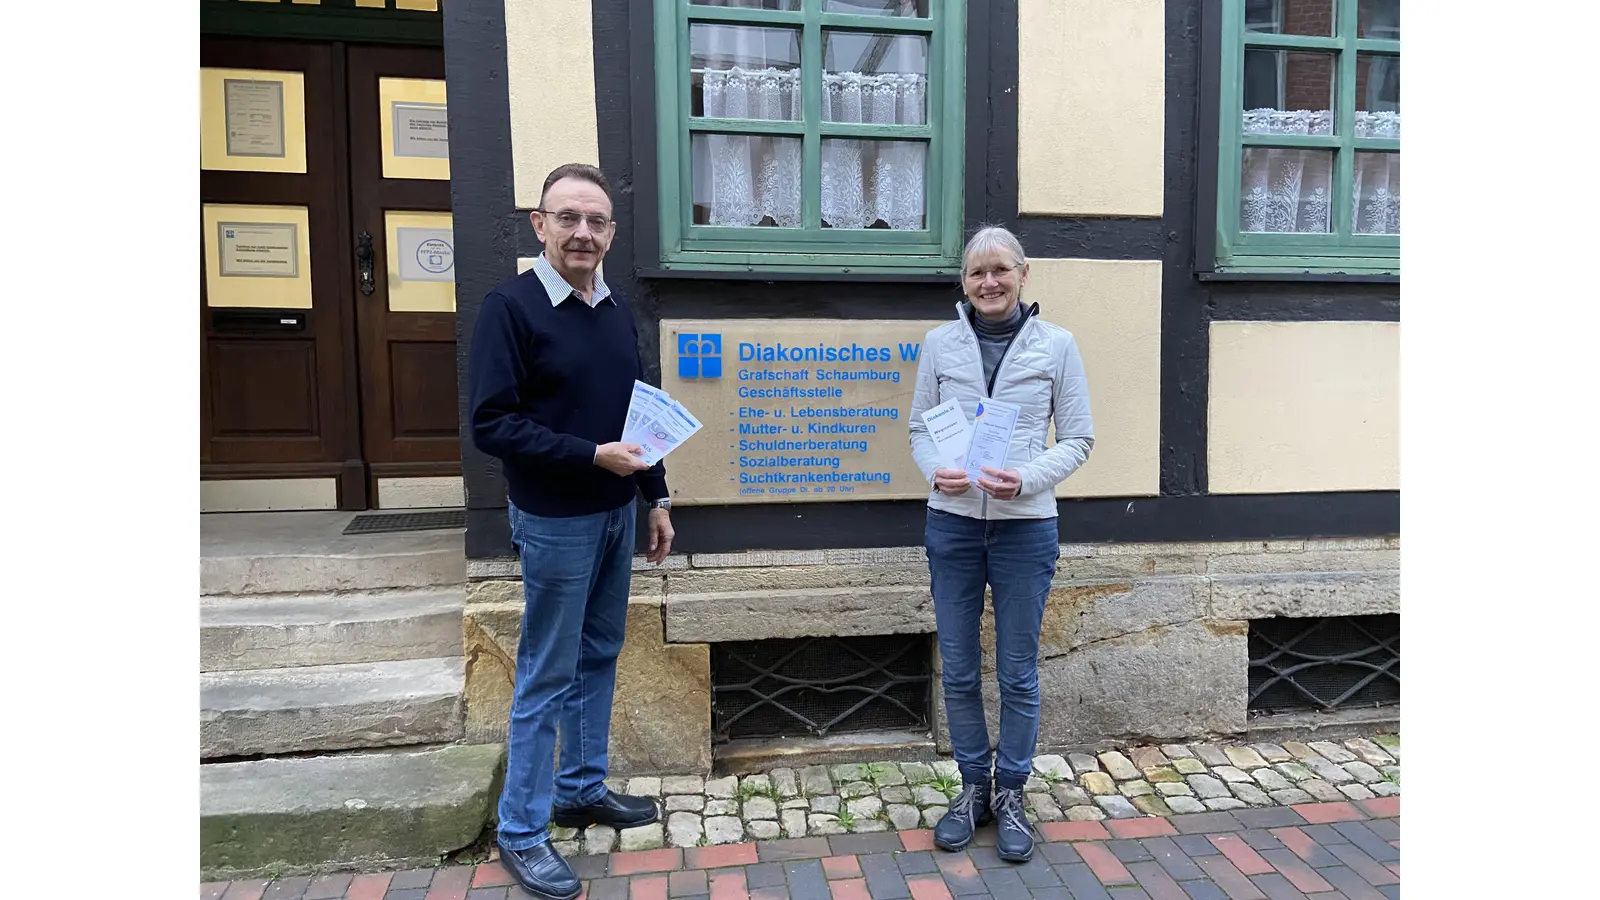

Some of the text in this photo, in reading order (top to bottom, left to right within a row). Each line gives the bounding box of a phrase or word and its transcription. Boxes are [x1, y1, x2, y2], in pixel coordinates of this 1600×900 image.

[738, 342, 920, 363] Diakonisches W
[738, 369, 900, 383] Grafschaft Schaumburg
[738, 386, 843, 398] Geschäftsstelle
[739, 407, 770, 418] Ehe-
[774, 410, 786, 418] u.
[790, 407, 899, 420] Lebensberatung
[739, 423, 787, 435] Mutter-
[791, 425, 803, 434] u.
[808, 423, 876, 434] Kindkuren
[739, 439, 868, 453] Schuldnerberatung
[739, 455, 840, 469] Sozialberatung
[739, 471, 891, 484] Suchtkrankenberatung
